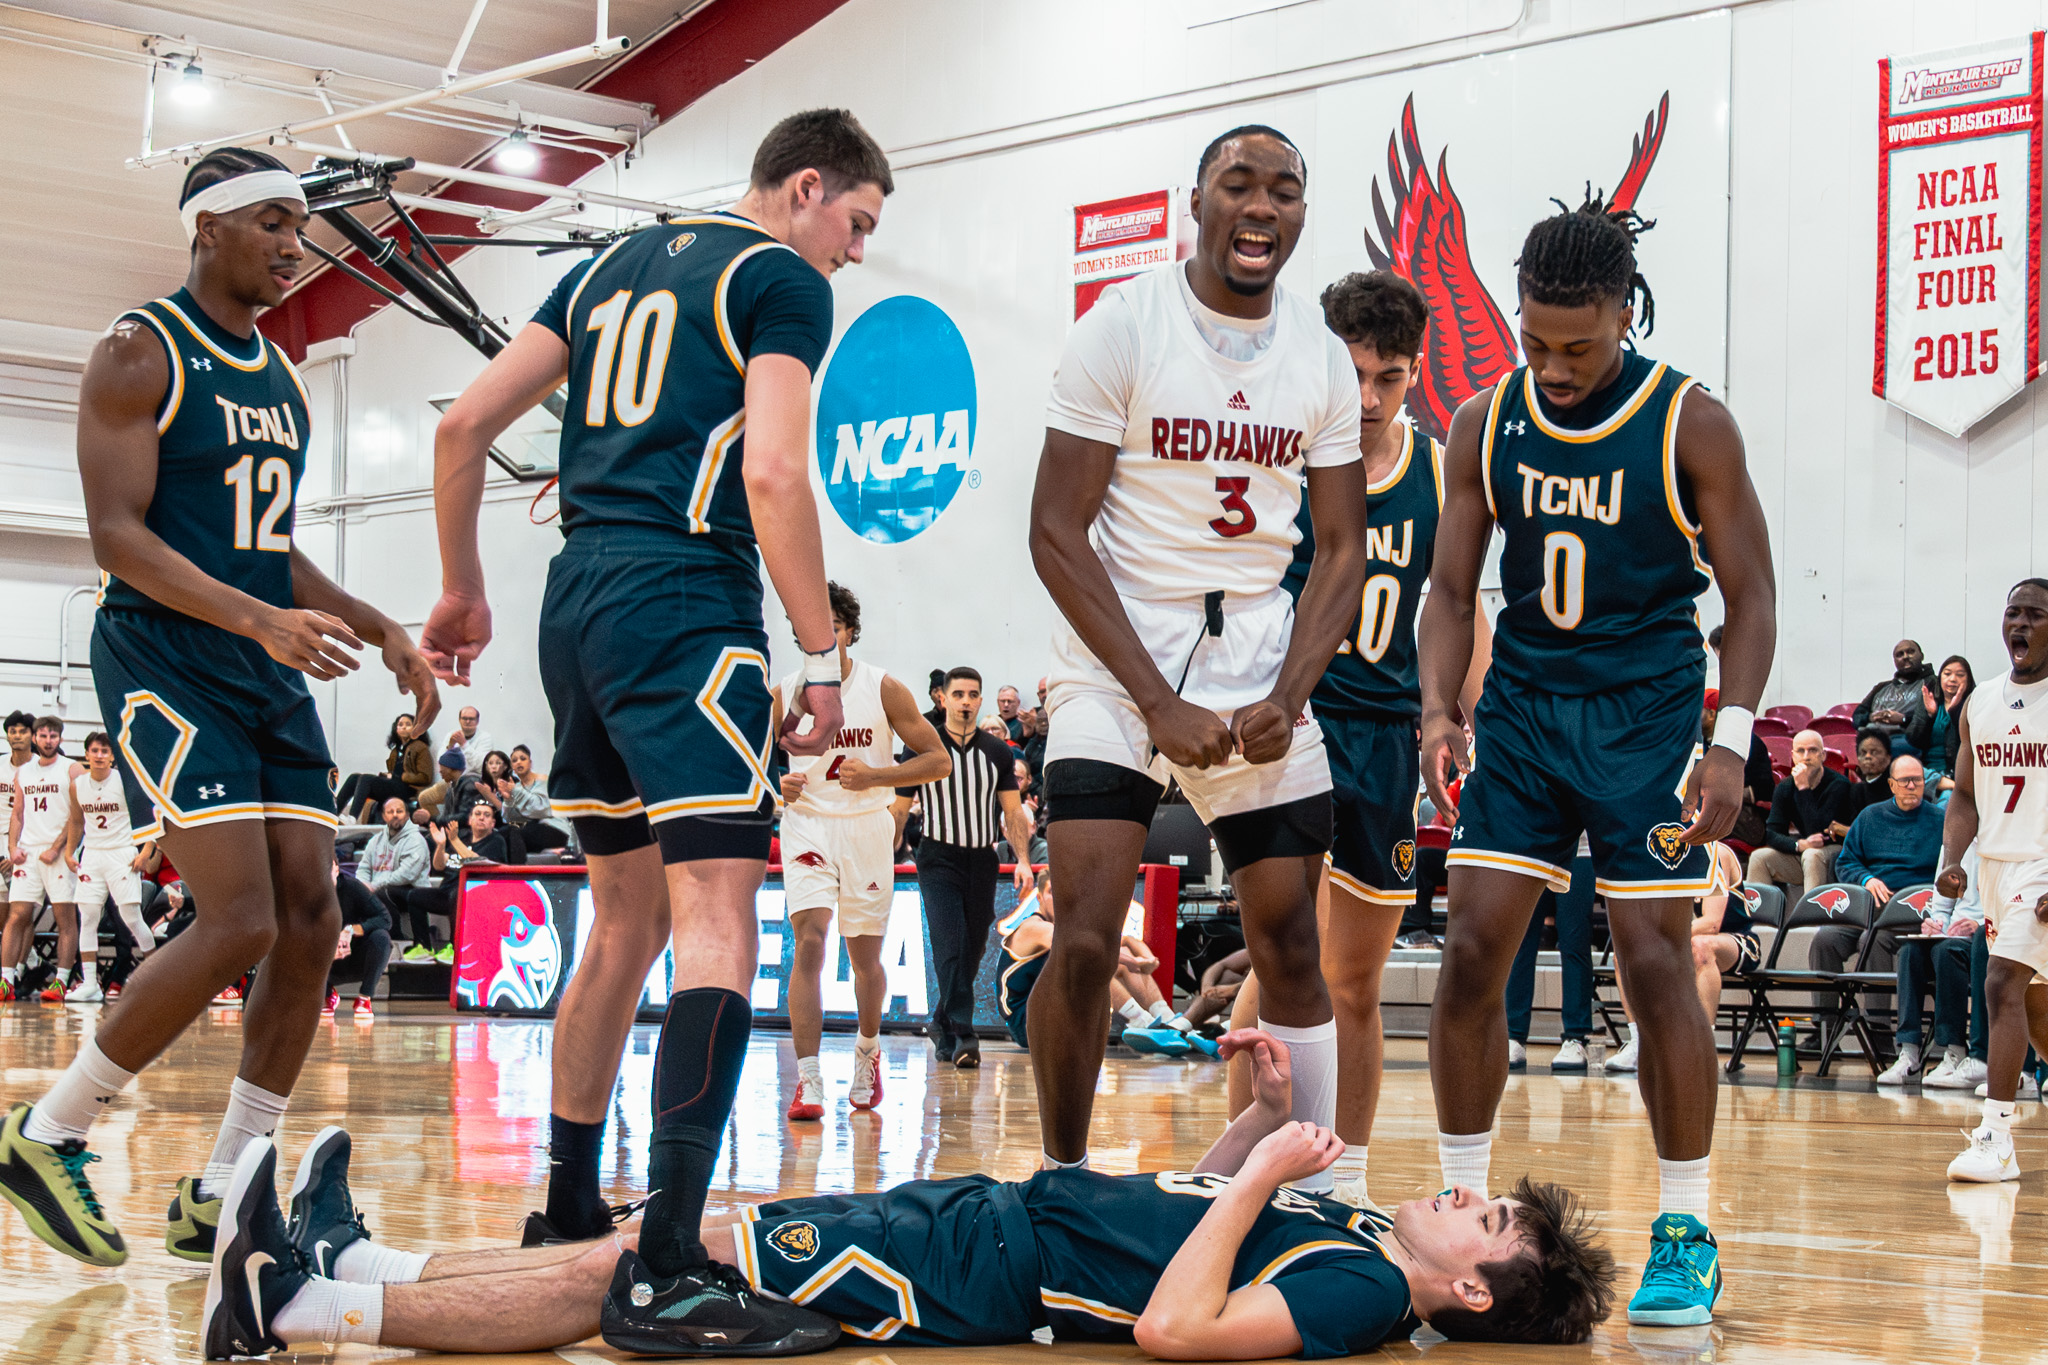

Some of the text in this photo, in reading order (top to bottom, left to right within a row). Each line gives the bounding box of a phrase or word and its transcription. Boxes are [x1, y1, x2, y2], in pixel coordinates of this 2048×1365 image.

[1899, 59, 2021, 104] MONTCLAIR STATE
[1888, 104, 2033, 143] WOMEN'S BASKETBALL
[1917, 162, 1999, 211] NCAA
[1913, 212, 2003, 261] FINAL
[1074, 247, 1169, 276] WOMEN'S BASKETBALL
[1916, 264, 1996, 310] FOUR
[586, 289, 678, 428] 10
[1913, 328, 1999, 382] 2015
[215, 394, 299, 450] TCNJ
[830, 409, 970, 485] NCAA
[224, 454, 292, 553] 12
[1208, 476, 1257, 538] 3
[1517, 462, 1625, 526] TCNJ
[1366, 519, 1414, 568] NJ
[1540, 531, 1586, 631] 0
[2002, 742, 2048, 768] HAWK
[33, 797, 48, 812] 14
[2002, 775, 2025, 813] 7
[96, 815, 107, 829] 2
